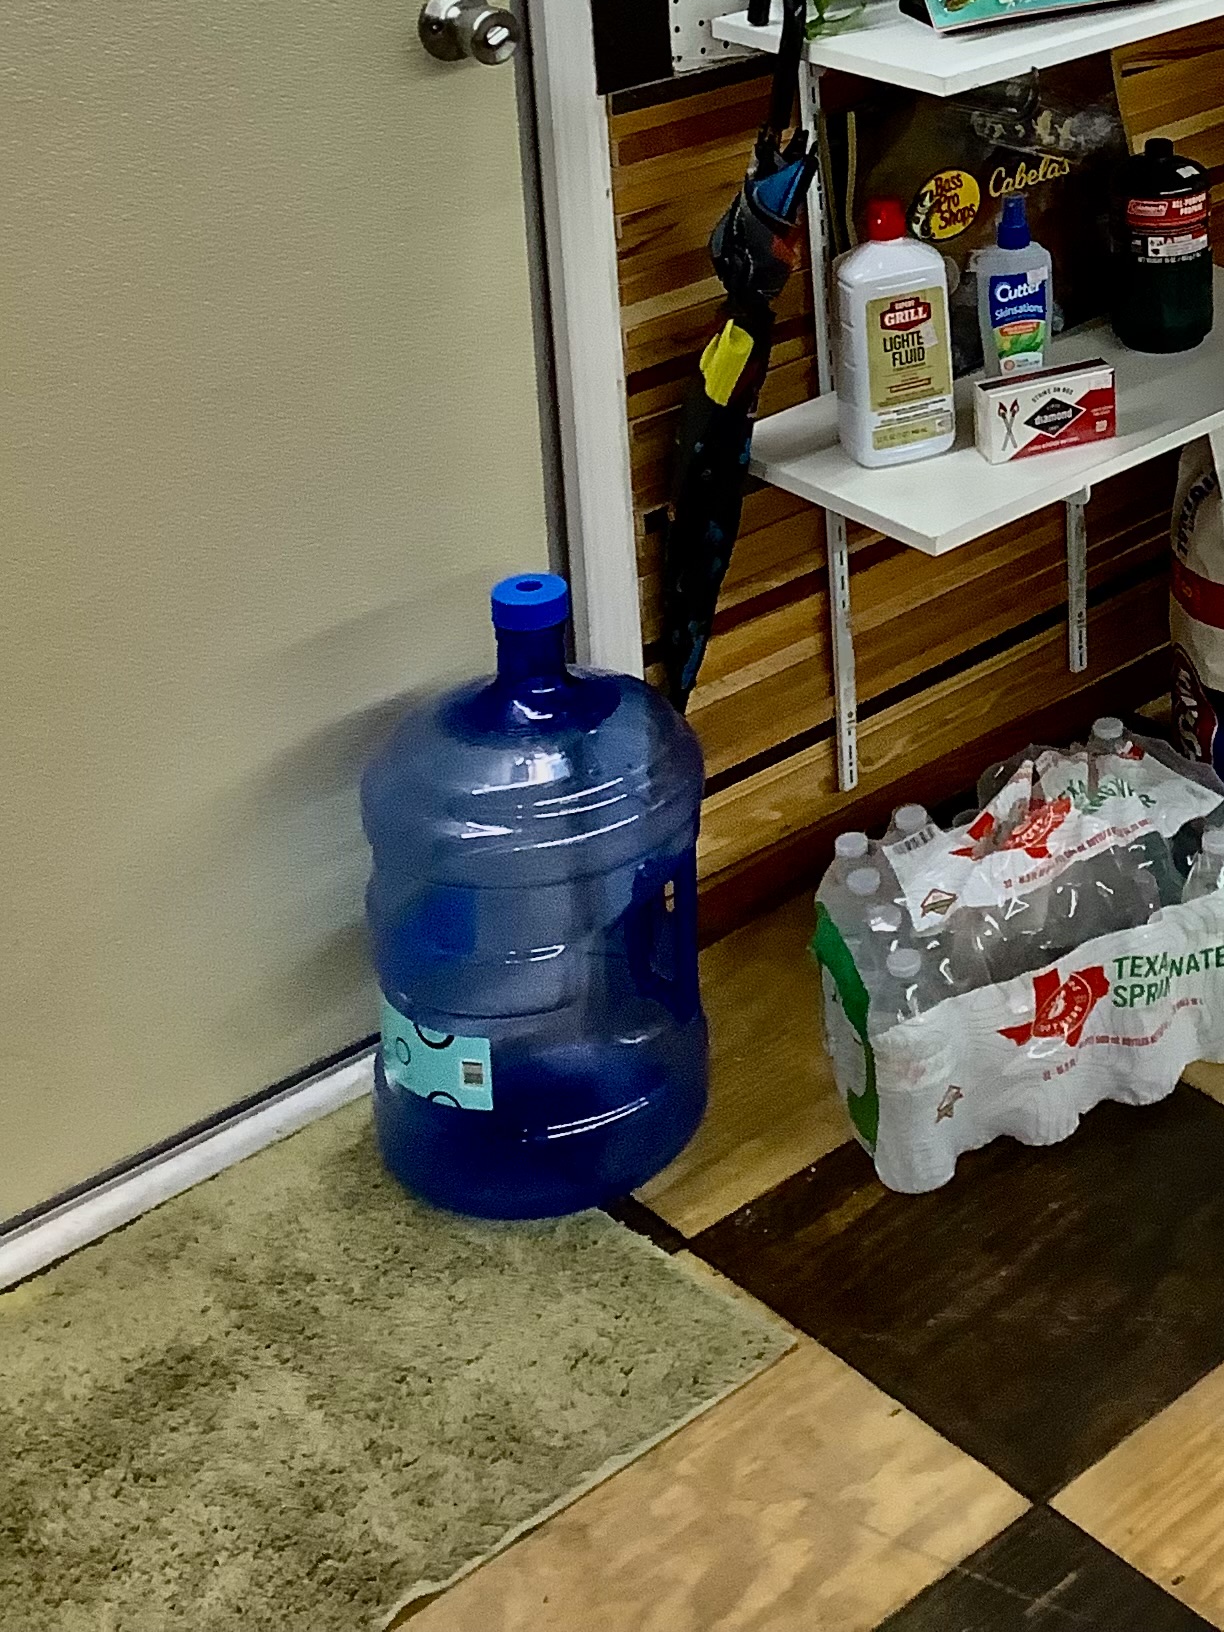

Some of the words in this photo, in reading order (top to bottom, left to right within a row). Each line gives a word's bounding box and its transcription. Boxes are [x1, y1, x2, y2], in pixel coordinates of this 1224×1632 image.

[934, 174, 964, 197] Bass
[938, 203, 976, 230] Shops
[995, 280, 1042, 303] Cutter
[883, 305, 929, 327] GRILL
[995, 303, 1043, 321] Skinsations
[883, 330, 924, 353] LIGHTE
[892, 346, 926, 367] FLUID
[1034, 407, 1074, 427] diamond
